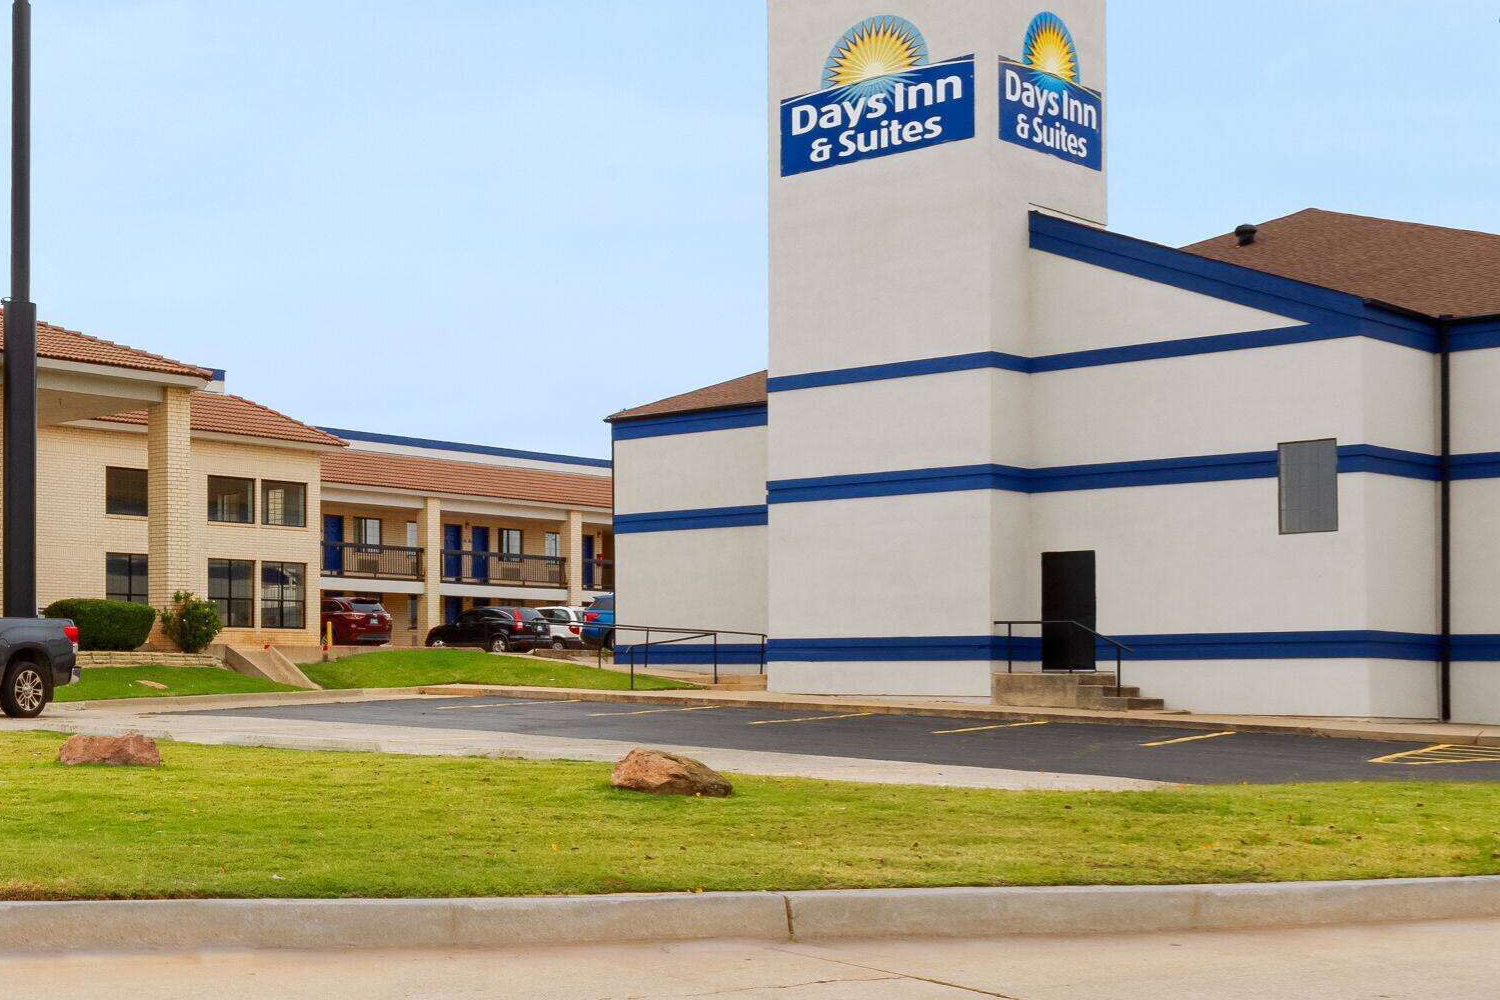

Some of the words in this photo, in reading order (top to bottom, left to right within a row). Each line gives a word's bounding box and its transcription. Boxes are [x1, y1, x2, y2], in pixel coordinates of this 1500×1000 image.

[791, 92, 887, 136] Days
[894, 75, 963, 113] Inn
[1005, 68, 1060, 117] Days
[1062, 89, 1098, 130] Inn
[809, 137, 832, 163] &
[838, 115, 943, 158] Suites
[1016, 113, 1030, 139] &
[1032, 116, 1088, 158] Suites
